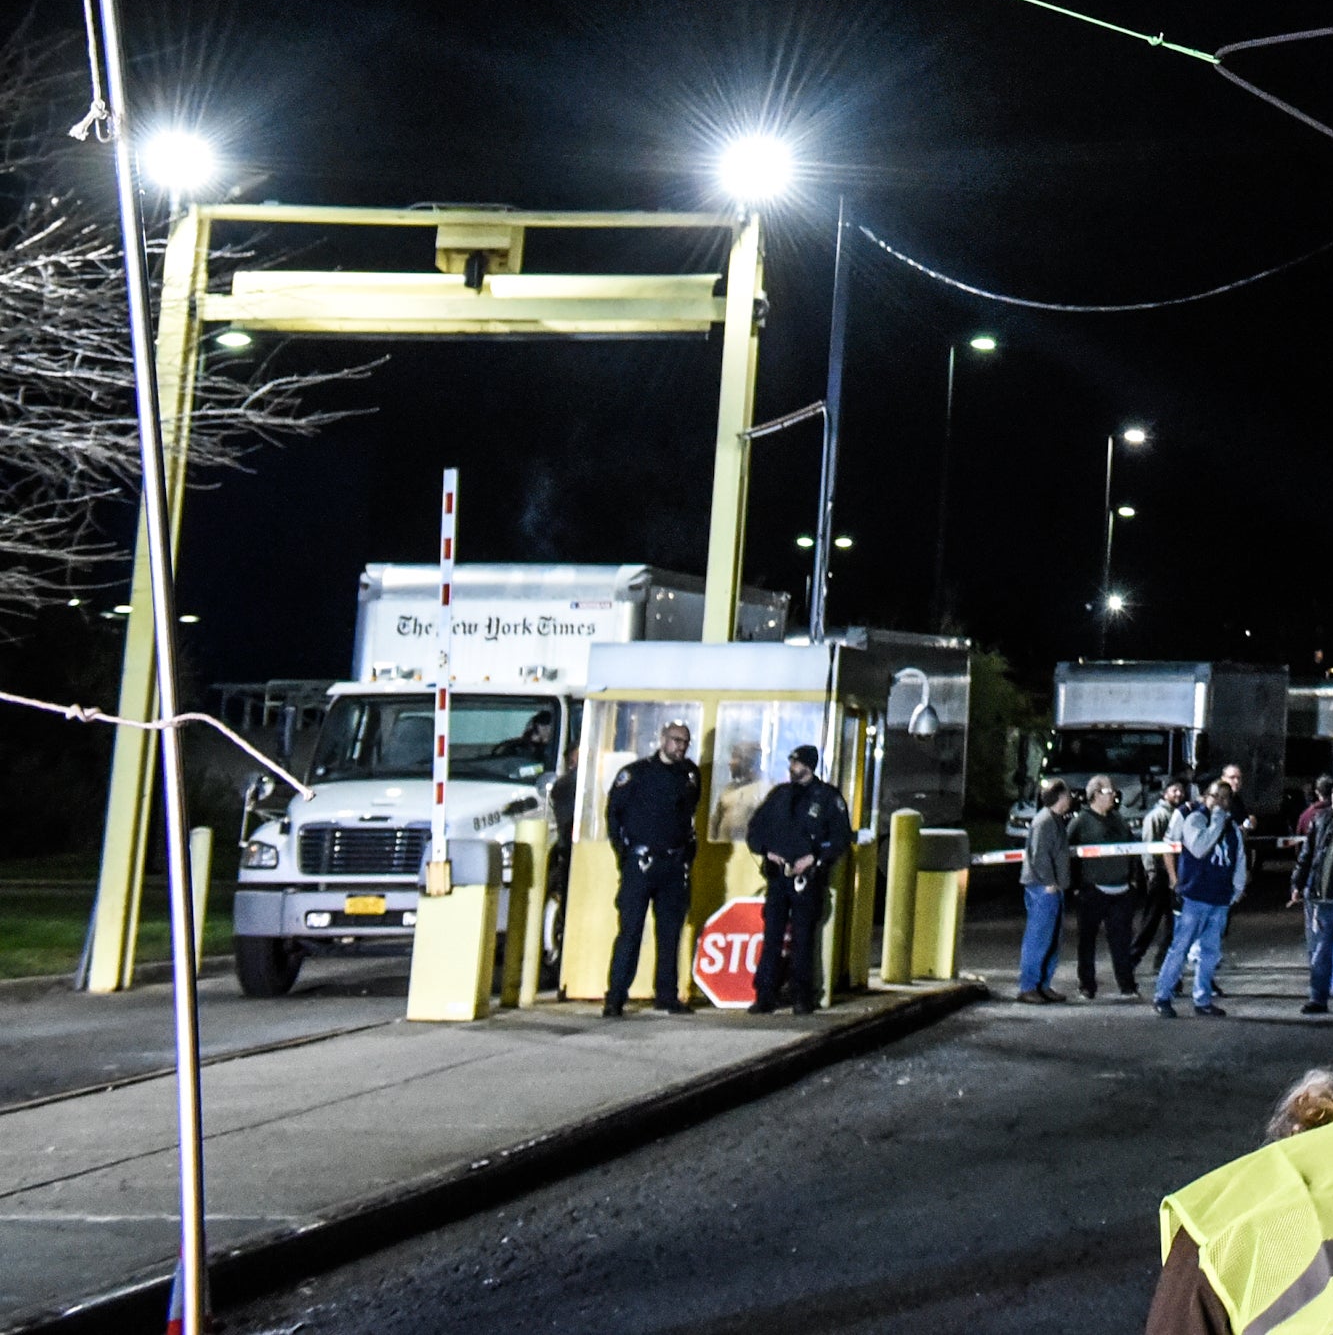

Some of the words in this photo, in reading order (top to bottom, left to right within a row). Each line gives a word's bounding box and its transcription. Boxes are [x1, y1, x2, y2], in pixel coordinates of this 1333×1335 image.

[397, 615, 432, 637] The
[435, 616, 478, 637] ew
[484, 615, 532, 641] York
[537, 616, 596, 637] Times
[700, 932, 791, 974] STO
